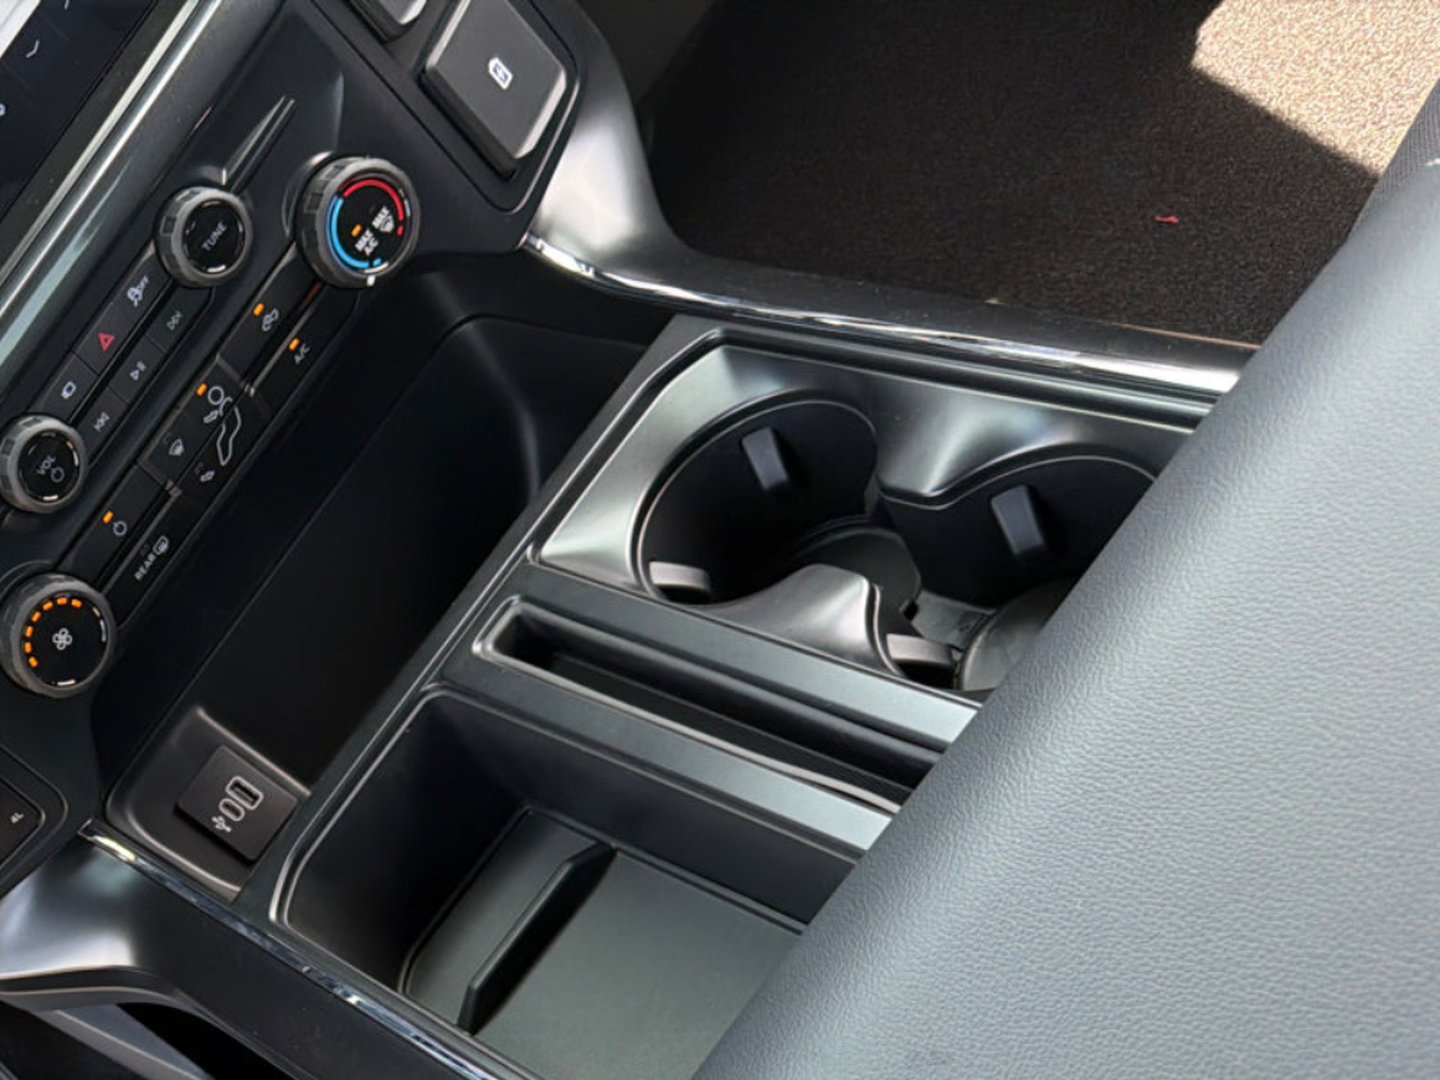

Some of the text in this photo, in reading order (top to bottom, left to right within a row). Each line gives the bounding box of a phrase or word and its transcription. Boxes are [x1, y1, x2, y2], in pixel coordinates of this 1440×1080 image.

[201, 221, 228, 252] TUNE
[36, 455, 57, 476] VOL
[133, 553, 157, 581] REAR
